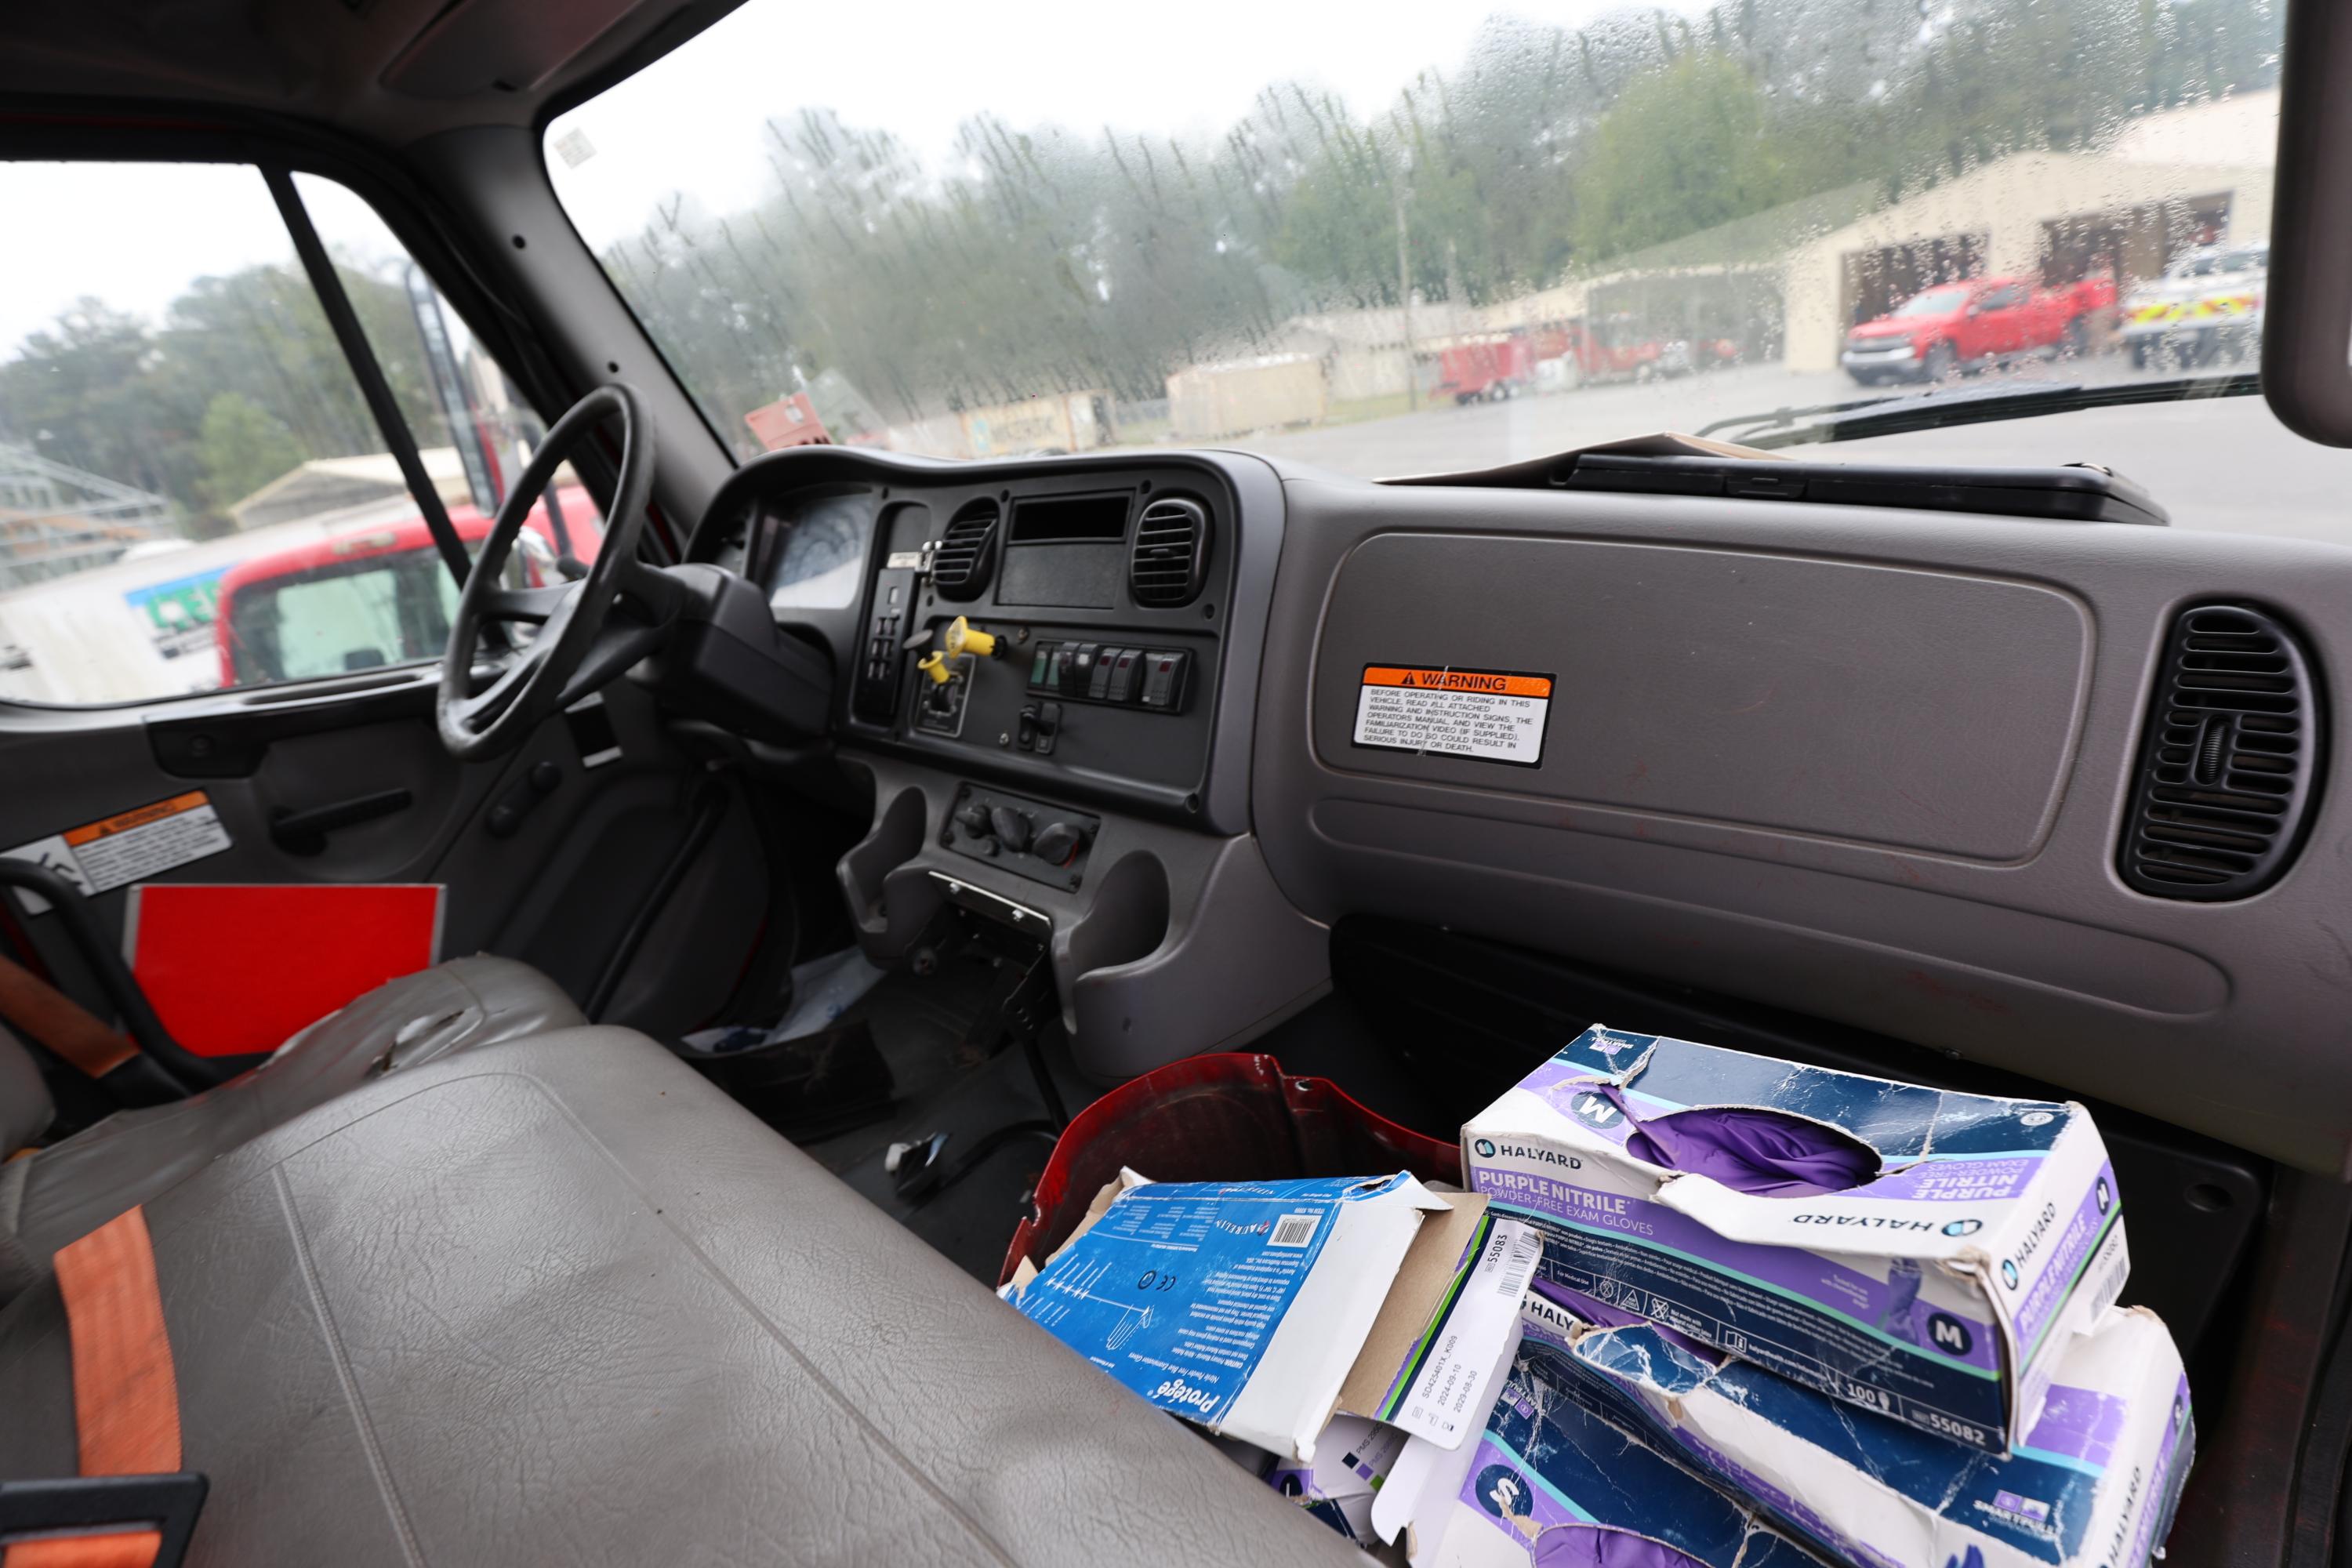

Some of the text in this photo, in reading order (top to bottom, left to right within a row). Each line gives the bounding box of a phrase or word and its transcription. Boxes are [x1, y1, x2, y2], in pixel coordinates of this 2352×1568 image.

[1421, 672, 1507, 690] WARNING
[1404, 691, 1448, 700] OPERATING
[1467, 695, 1495, 705] RIDING
[1448, 702, 1490, 712] ATTACHED
[1425, 708, 1480, 720] INSTRUCTION
[1363, 735, 1397, 743] SERIOUS
[1364, 727, 1396, 735] FAILURE
[1442, 734, 1469, 743] COULD
[1472, 737, 1504, 746] RESULT
[1432, 725, 1457, 734] VIDEO
[1579, 1095, 1617, 1123] M
[1501, 1144, 1582, 1170] HALYARD
[1927, 1159, 2030, 1171] EXAM GLOVES
[1479, 1171, 1550, 1196] PURPLE
[1920, 1173, 2019, 1189] NITRILE
[1912, 1185, 2012, 1200] PURPLE
[1480, 1185, 1653, 1236] POWDER-FREE EXAM GLOVES
[1215, 1220, 1258, 1235] AURELIA
[1793, 1214, 1933, 1232] HALYARD
[2014, 1202, 2056, 1269] HALYARD
[1487, 1234, 1508, 1263] 55083
[1530, 1299, 1574, 1331] HALY
[1935, 1320, 1963, 1350] M
[1437, 1363, 1462, 1406] 2024-09-10
[1454, 1370, 1478, 1414] 2029-08-30
[1847, 1382, 1875, 1403] 100
[1929, 1414, 1987, 1446] 55082
